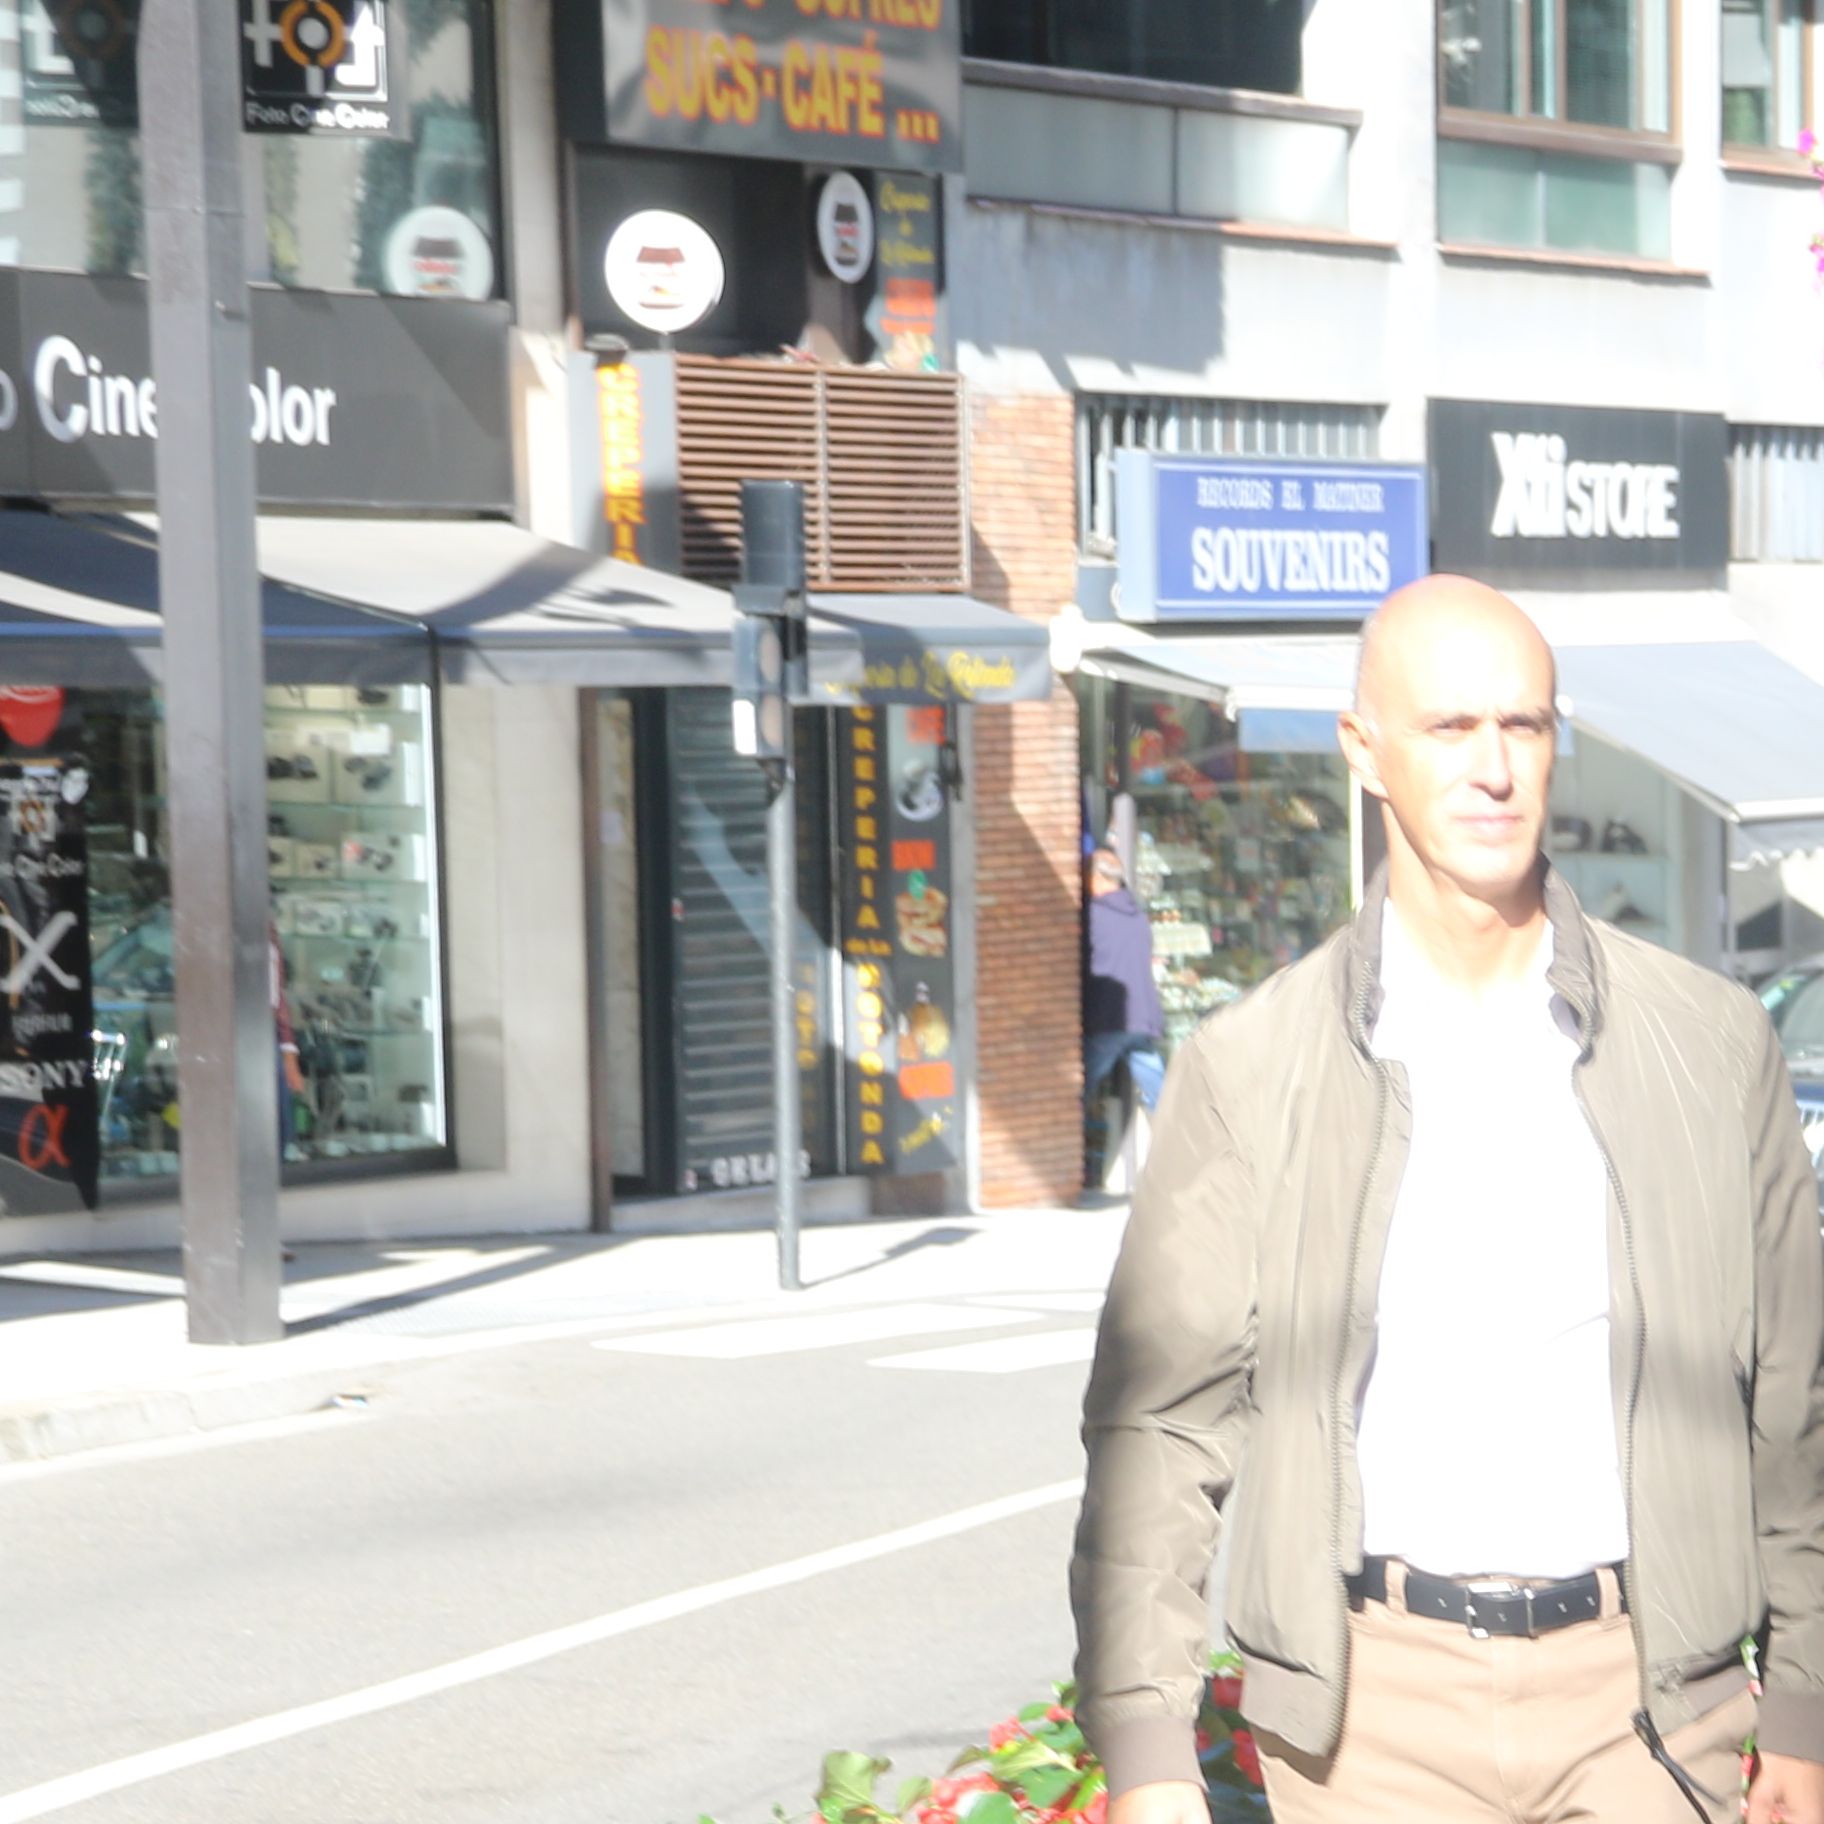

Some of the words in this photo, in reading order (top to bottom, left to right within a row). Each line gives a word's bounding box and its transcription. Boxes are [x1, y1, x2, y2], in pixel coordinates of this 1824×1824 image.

[645, 24, 759, 126] SUCS
[782, 29, 885, 138] CAFÉ
[249, 366, 337, 446] olor
[1197, 477, 1274, 510] RECORDS
[1566, 459, 1681, 540] STORE
[1191, 526, 1390, 593] SOUVENIRS
